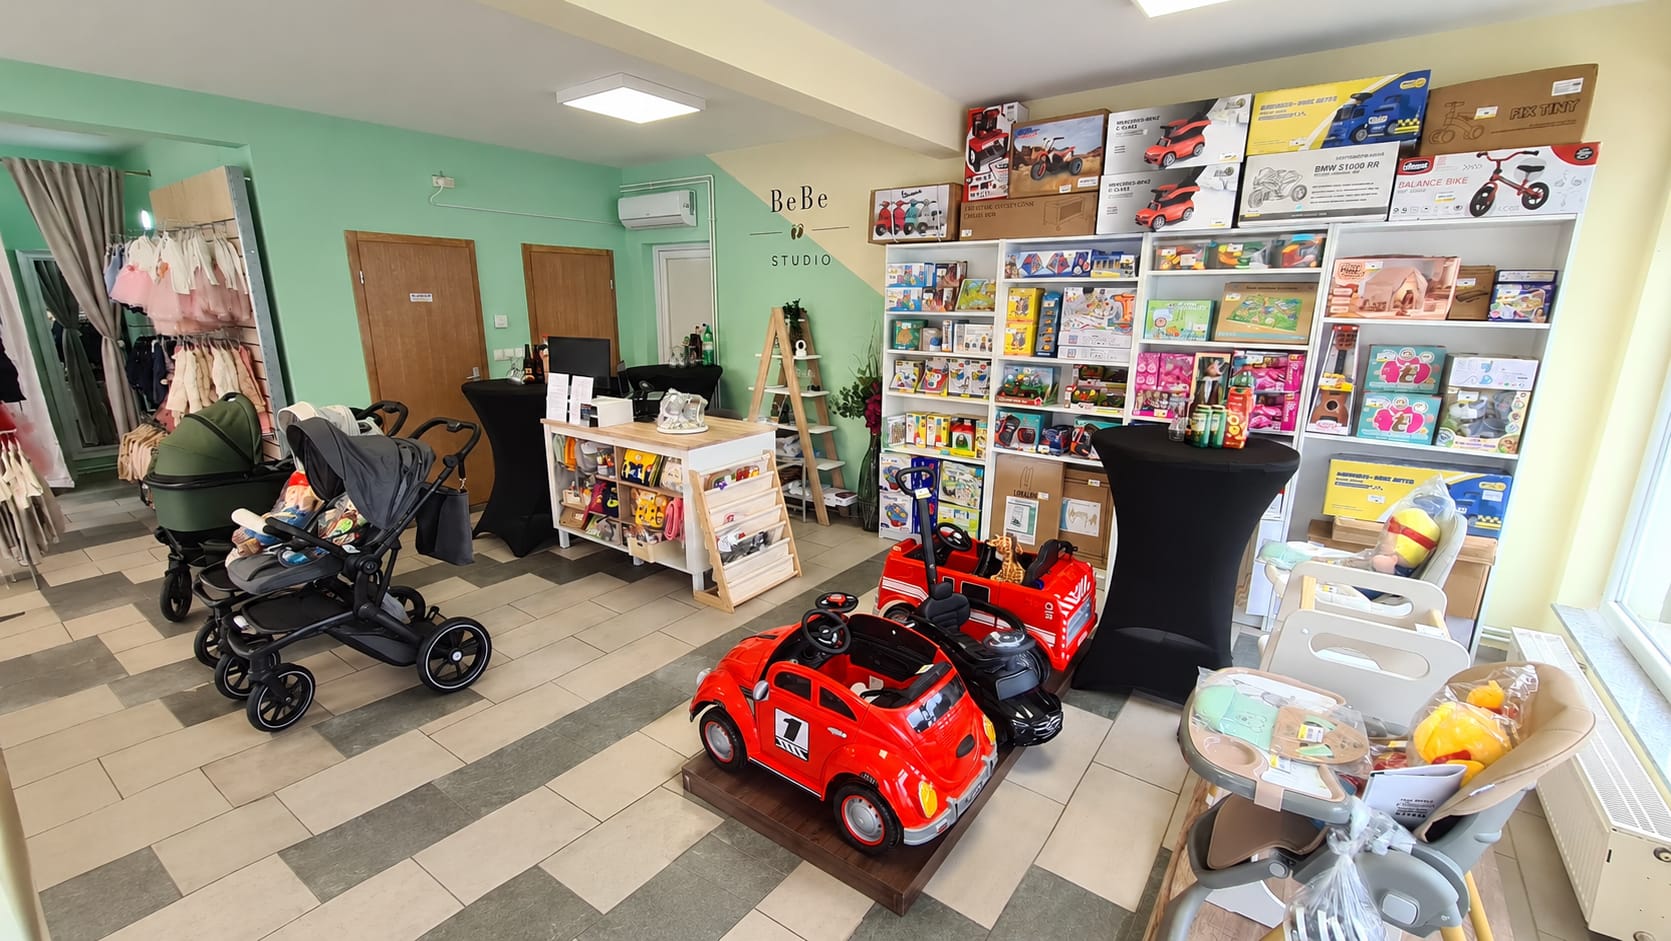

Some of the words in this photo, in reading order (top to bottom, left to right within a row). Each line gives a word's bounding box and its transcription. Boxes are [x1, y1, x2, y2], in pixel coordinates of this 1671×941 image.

[1509, 105, 1538, 121] FIX
[1540, 99, 1579, 117] TINY
[1314, 164, 1337, 173] BMW
[1338, 162, 1365, 171] S1000
[1366, 160, 1380, 169] RR
[1398, 178, 1443, 189] BALANCE
[1445, 176, 1469, 186] BIKE
[771, 185, 828, 213] BeBe
[771, 254, 831, 267] STUDIO
[783, 717, 802, 742] 1
